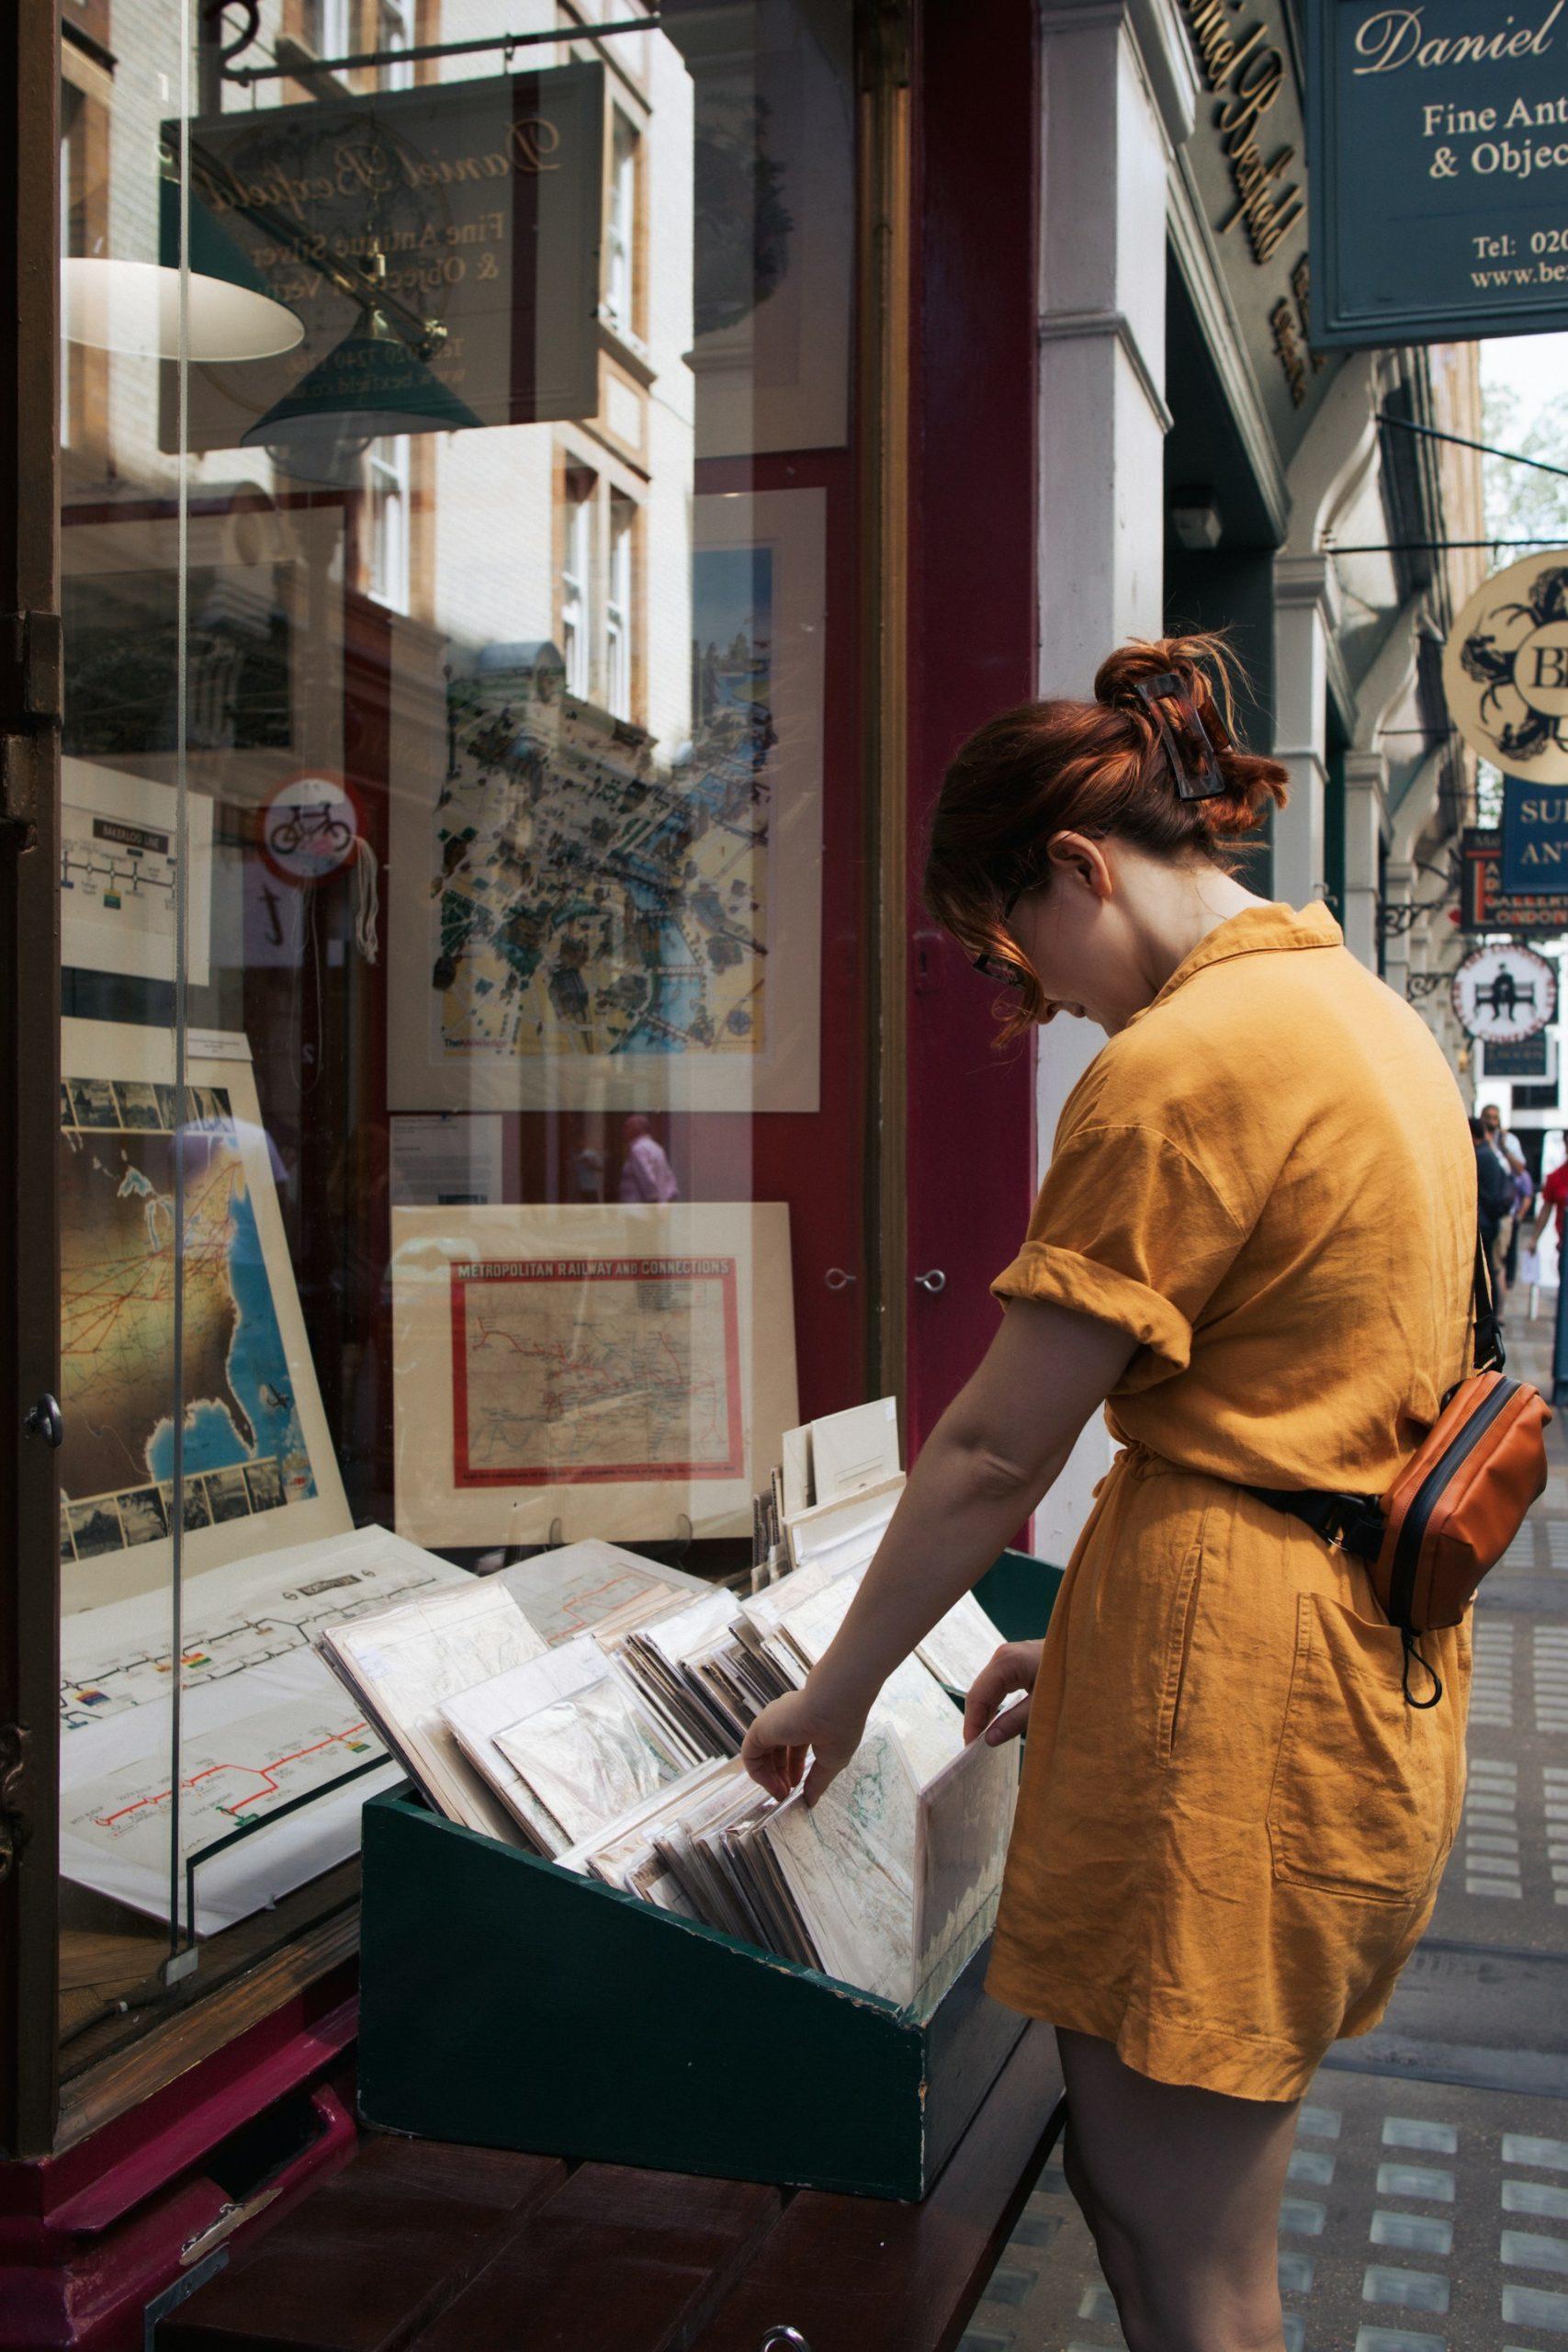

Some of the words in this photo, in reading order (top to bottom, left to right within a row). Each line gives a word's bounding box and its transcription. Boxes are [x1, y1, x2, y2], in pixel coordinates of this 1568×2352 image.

[1352, 1, 1564, 75] Daniel
[1422, 103, 1497, 137] Fine
[1503, 96, 1568, 130] Ant
[1428, 146, 1459, 179] &
[1471, 138, 1568, 179] Objec
[1472, 235, 1517, 259] Tel:
[1470, 260, 1568, 288] www.be
[1529, 645, 1568, 689] B
[458, 1263, 554, 1279] METROPOLITAN
[558, 1261, 614, 1278] RAILWAY
[615, 1262, 638, 1276] AND
[642, 1259, 729, 1275] CONNECTIONS
